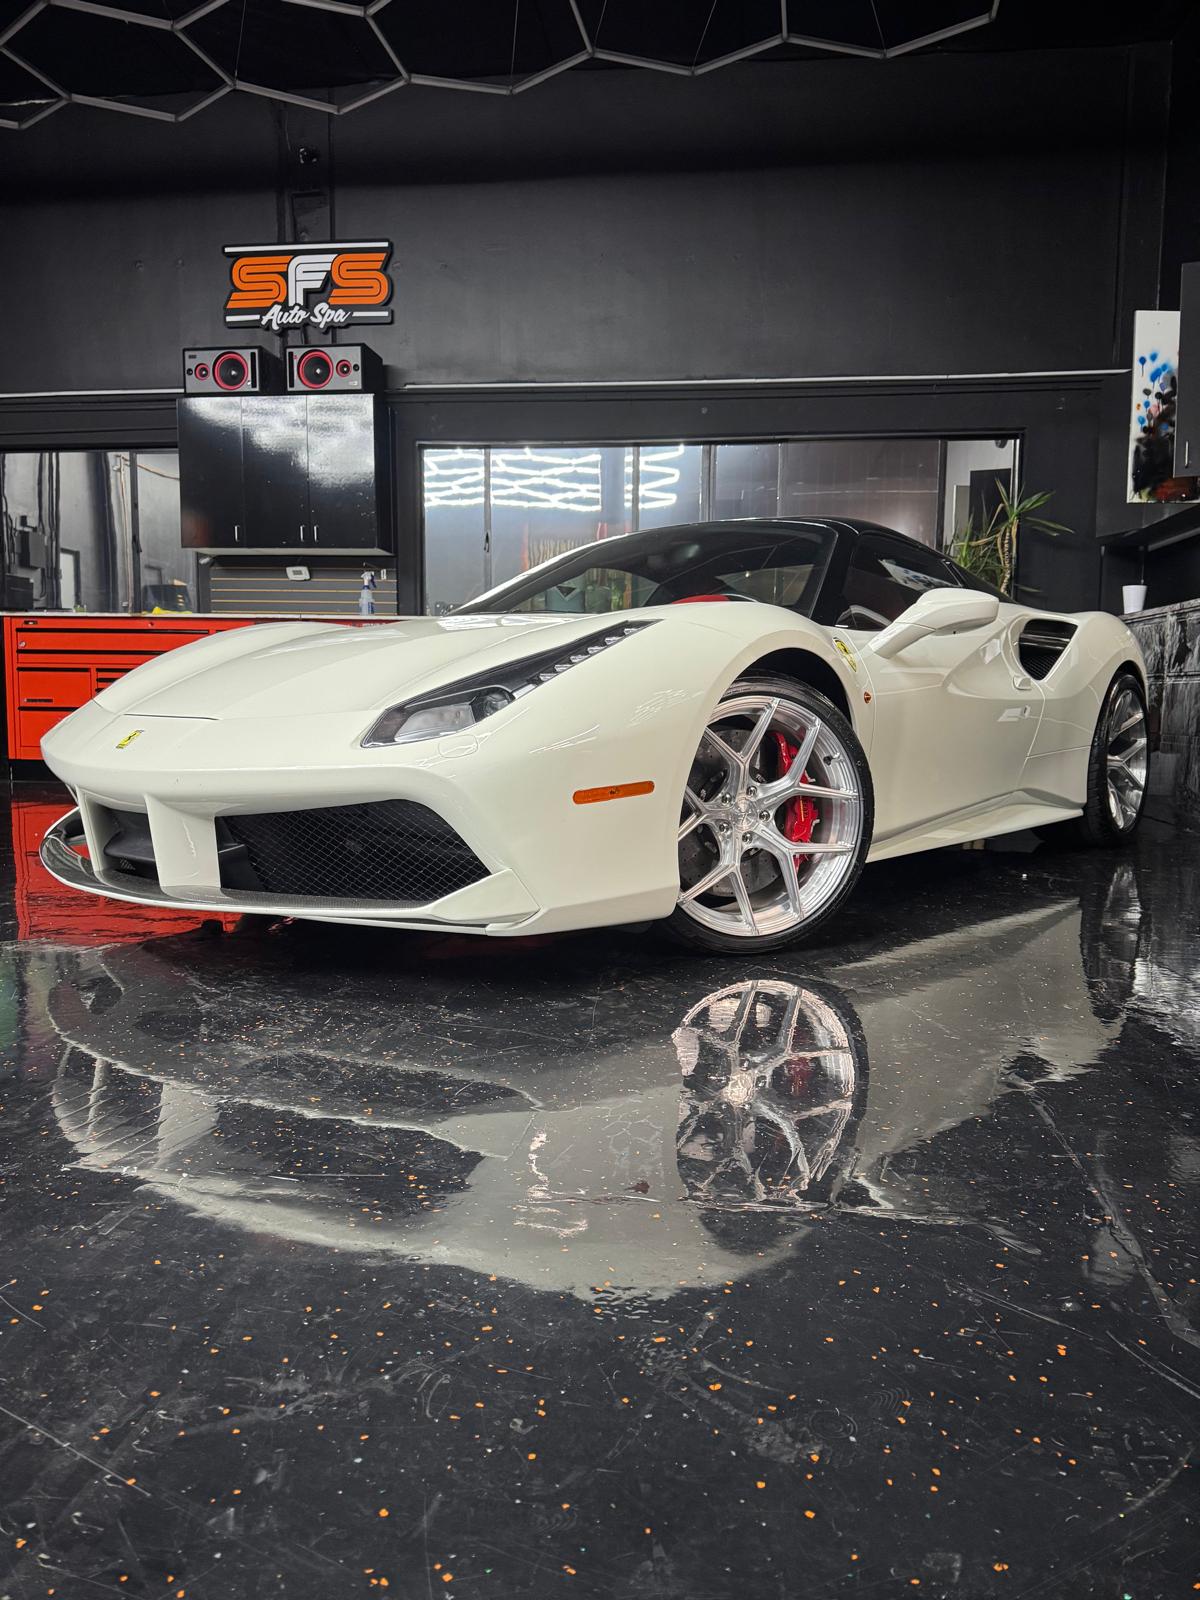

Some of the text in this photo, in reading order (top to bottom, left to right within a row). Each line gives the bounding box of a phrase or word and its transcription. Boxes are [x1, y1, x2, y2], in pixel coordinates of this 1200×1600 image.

[226, 252, 389, 308] SFS
[261, 302, 350, 330] Auto Spa
